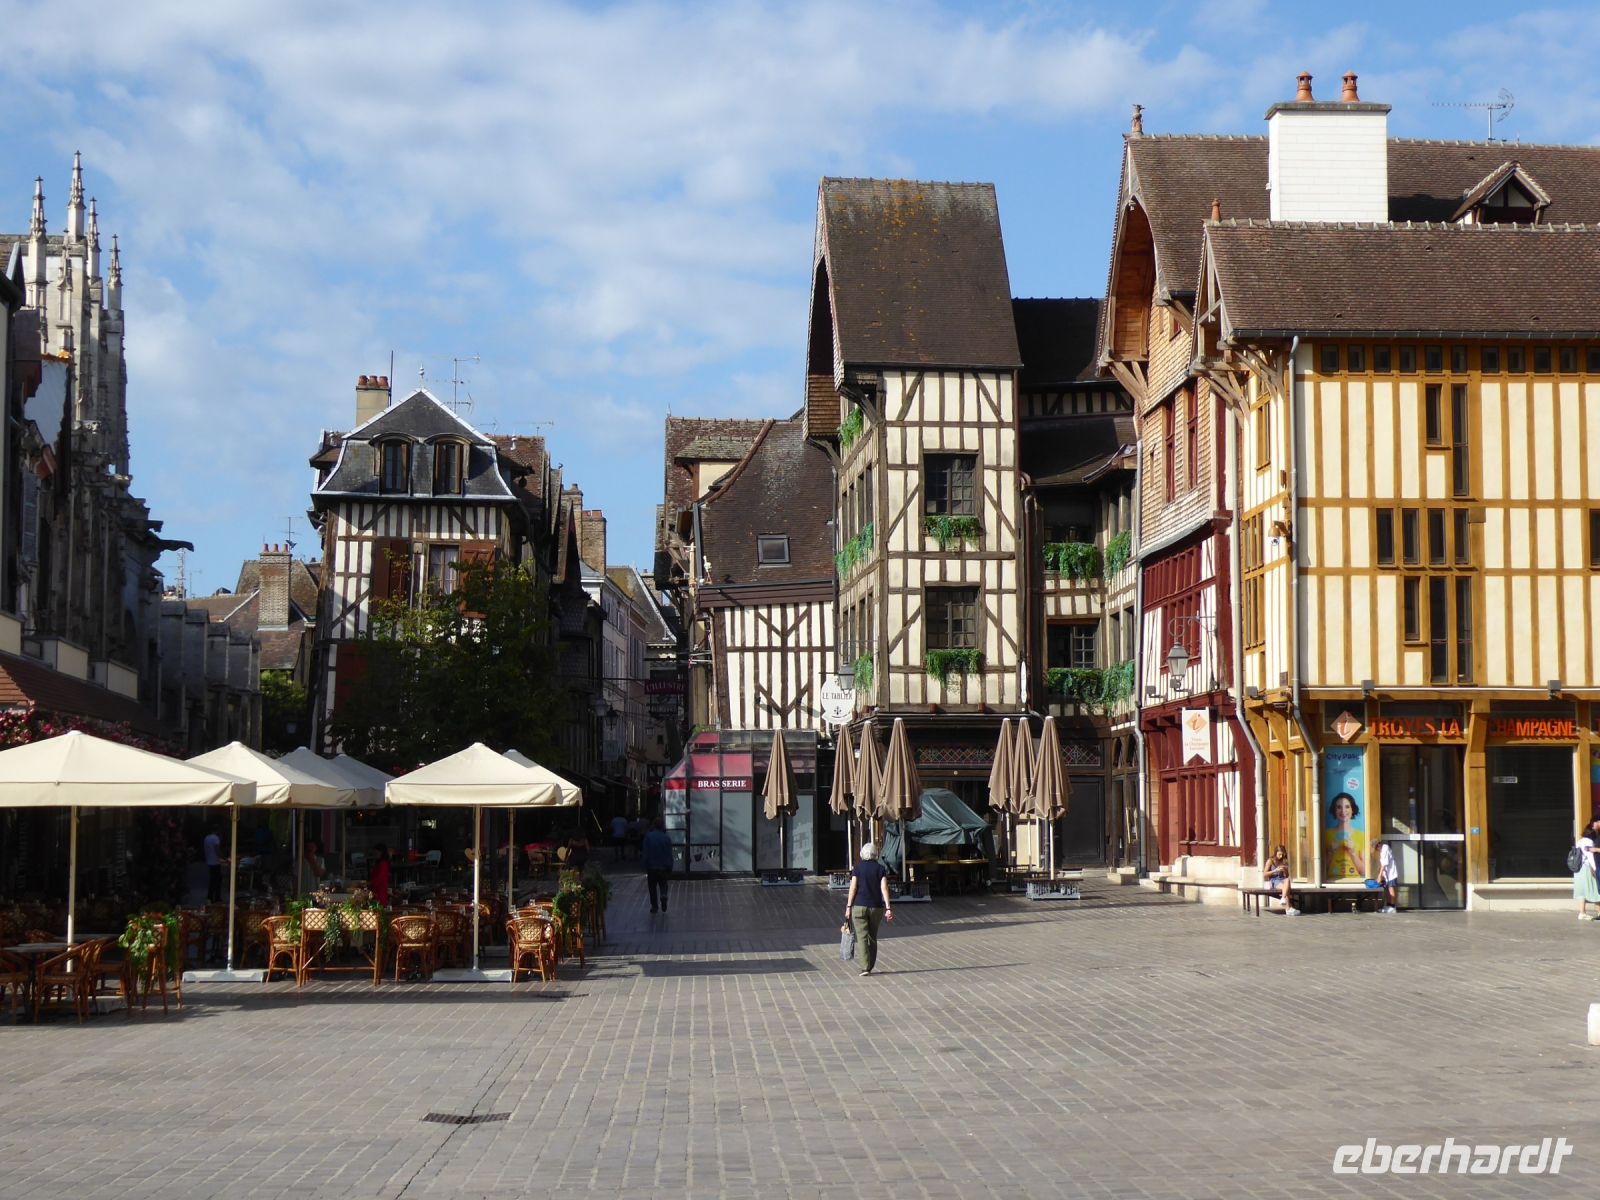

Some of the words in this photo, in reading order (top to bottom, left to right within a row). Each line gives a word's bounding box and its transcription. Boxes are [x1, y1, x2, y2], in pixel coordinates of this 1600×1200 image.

[822, 692, 829, 700] LE
[1370, 717, 1437, 737] TROYES
[1440, 718, 1461, 737] LA
[1488, 718, 1577, 737] CHAMPAGNE
[697, 780, 747, 788] BRASSERIE
